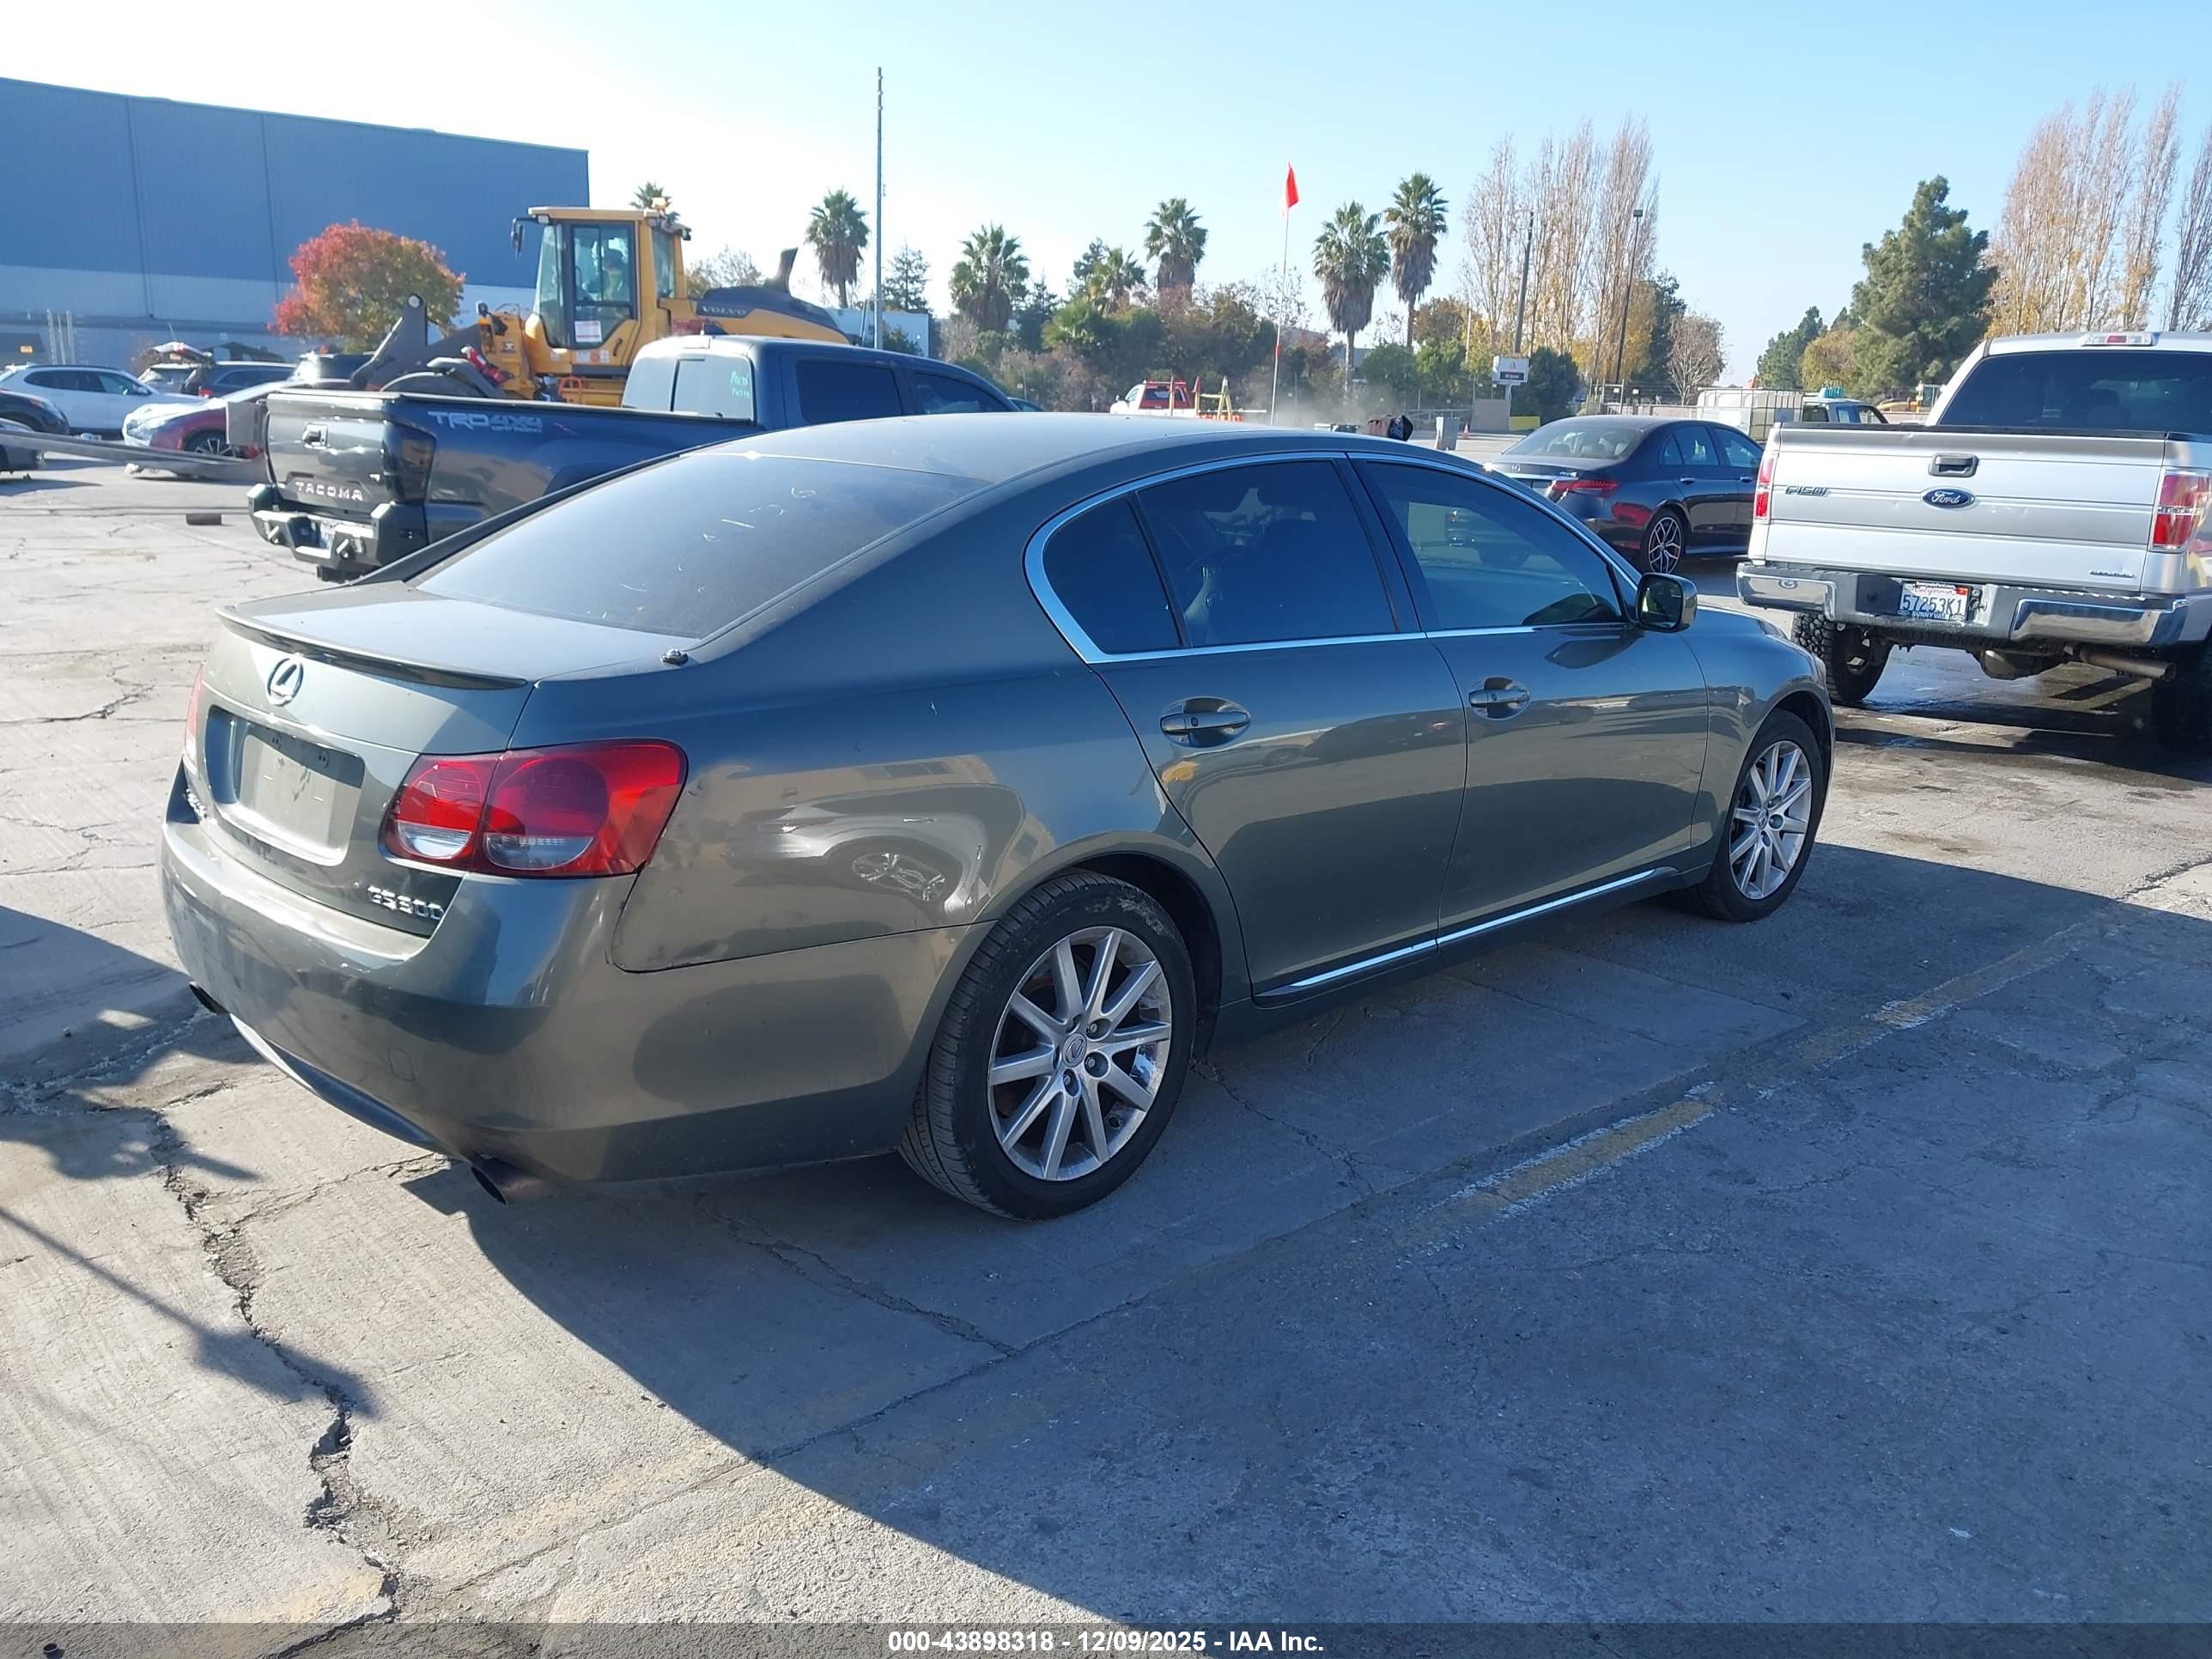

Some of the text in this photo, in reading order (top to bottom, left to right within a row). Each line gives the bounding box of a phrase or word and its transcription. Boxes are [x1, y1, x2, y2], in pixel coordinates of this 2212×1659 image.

[702, 306, 746, 315] VOLVO
[428, 410, 489, 429] TRD
[295, 481, 363, 501] TACOMA
[1932, 490, 1961, 504] Ford
[1903, 595, 1962, 616] 57253K1
